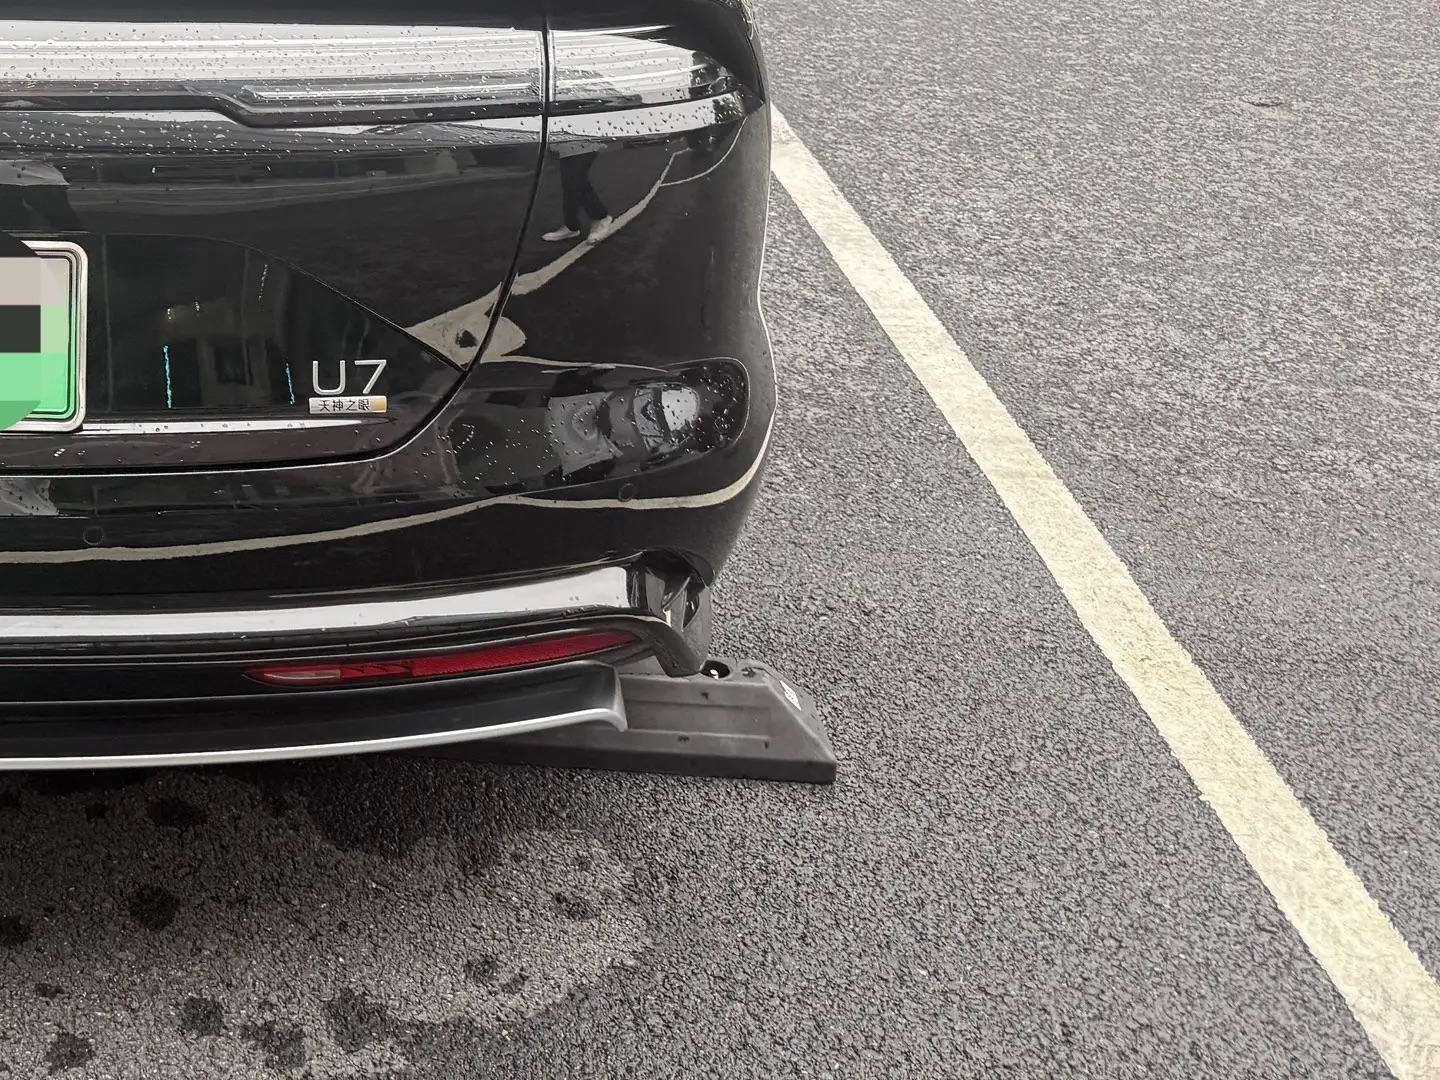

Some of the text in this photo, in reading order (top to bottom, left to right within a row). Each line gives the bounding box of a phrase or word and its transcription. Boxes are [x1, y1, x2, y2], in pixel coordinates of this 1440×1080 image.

[312, 359, 387, 396] U7
[319, 398, 370, 412] 天神之眼
